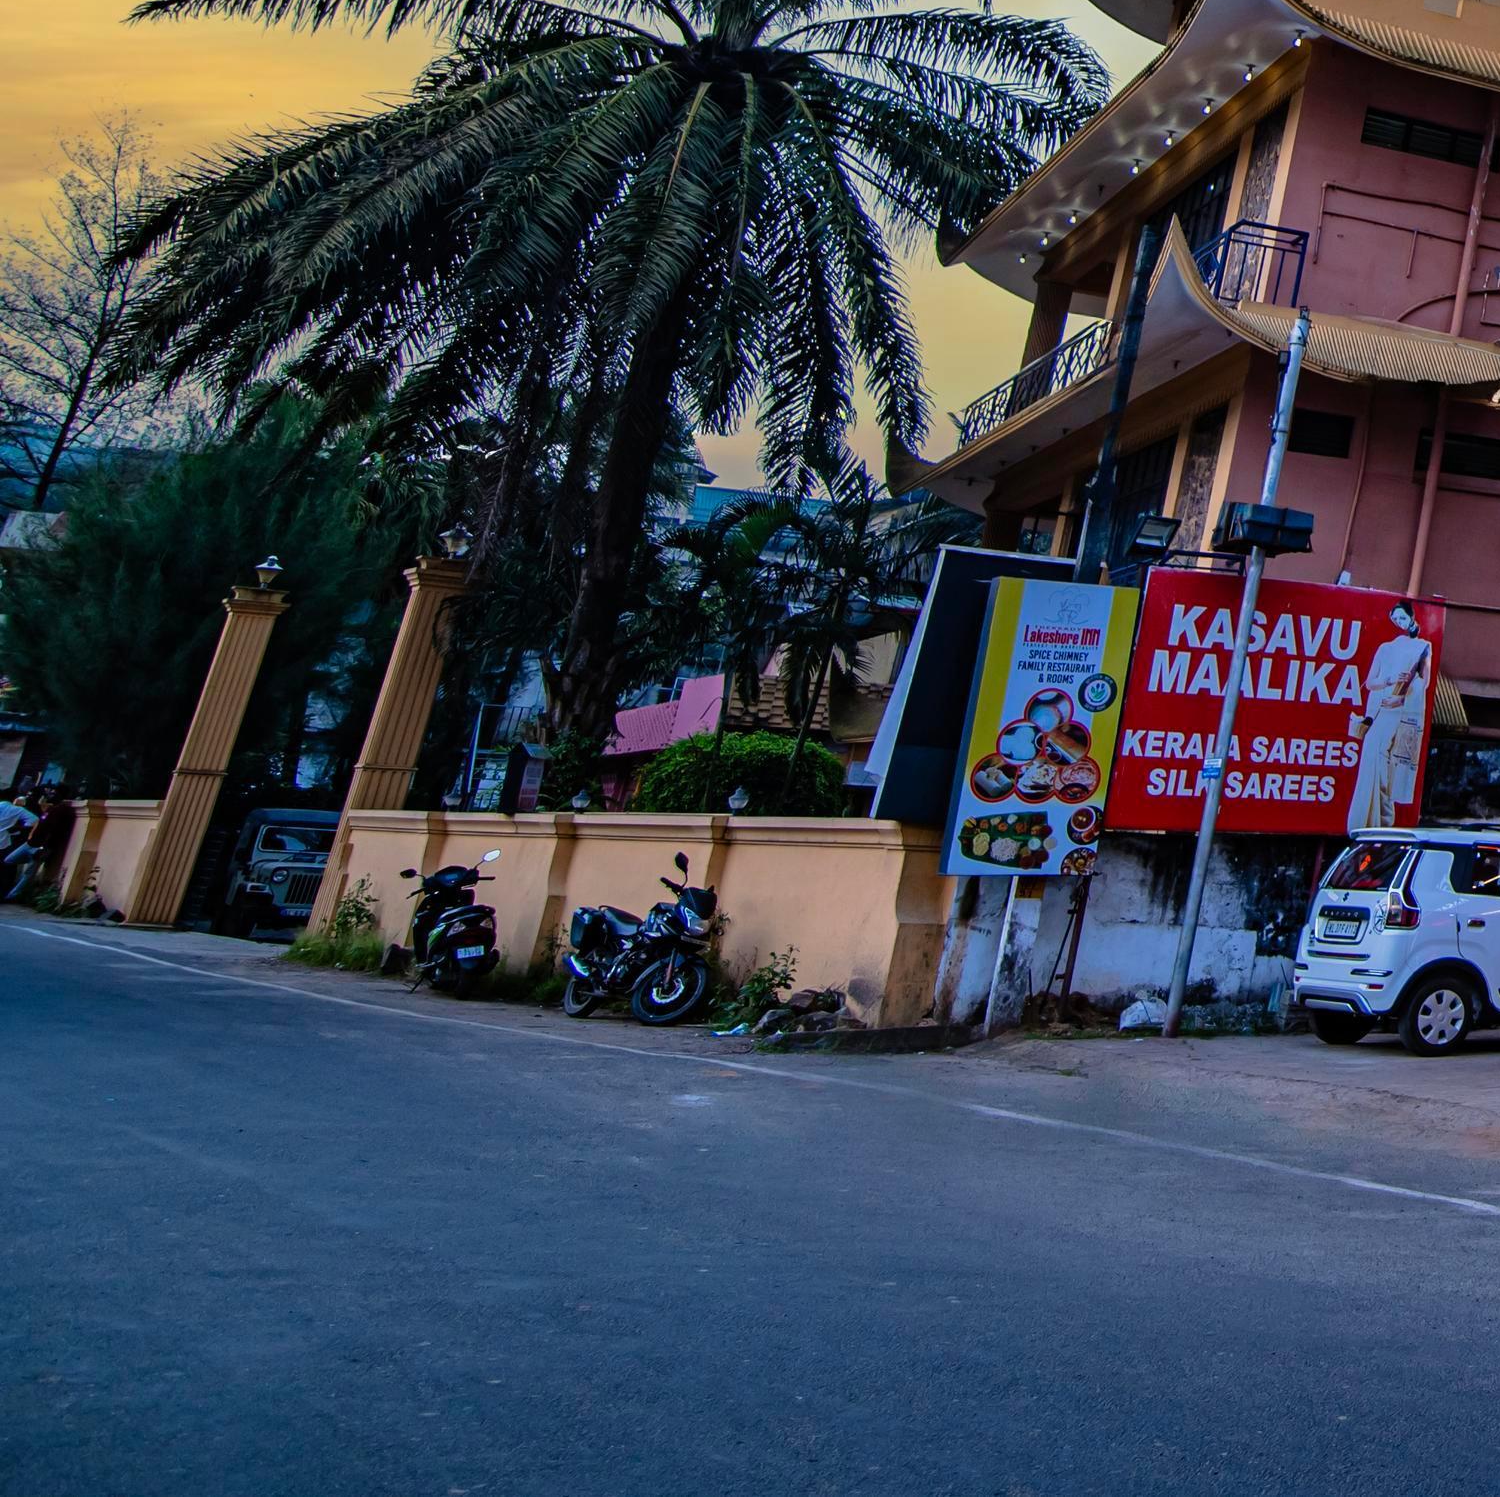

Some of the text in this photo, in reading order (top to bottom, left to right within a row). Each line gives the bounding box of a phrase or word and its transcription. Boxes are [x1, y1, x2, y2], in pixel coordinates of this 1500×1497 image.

[1024, 625, 1101, 646] Lakeshore INN
[1167, 603, 1362, 661] KASAVU
[1029, 650, 1089, 662] SPICE CHIMNEY
[1017, 661, 1096, 674] FAMILY RESTAURANT
[1046, 674, 1075, 684] ROOMS
[1250, 736, 1360, 768] SAREES
[1224, 771, 1336, 803] SAREES
